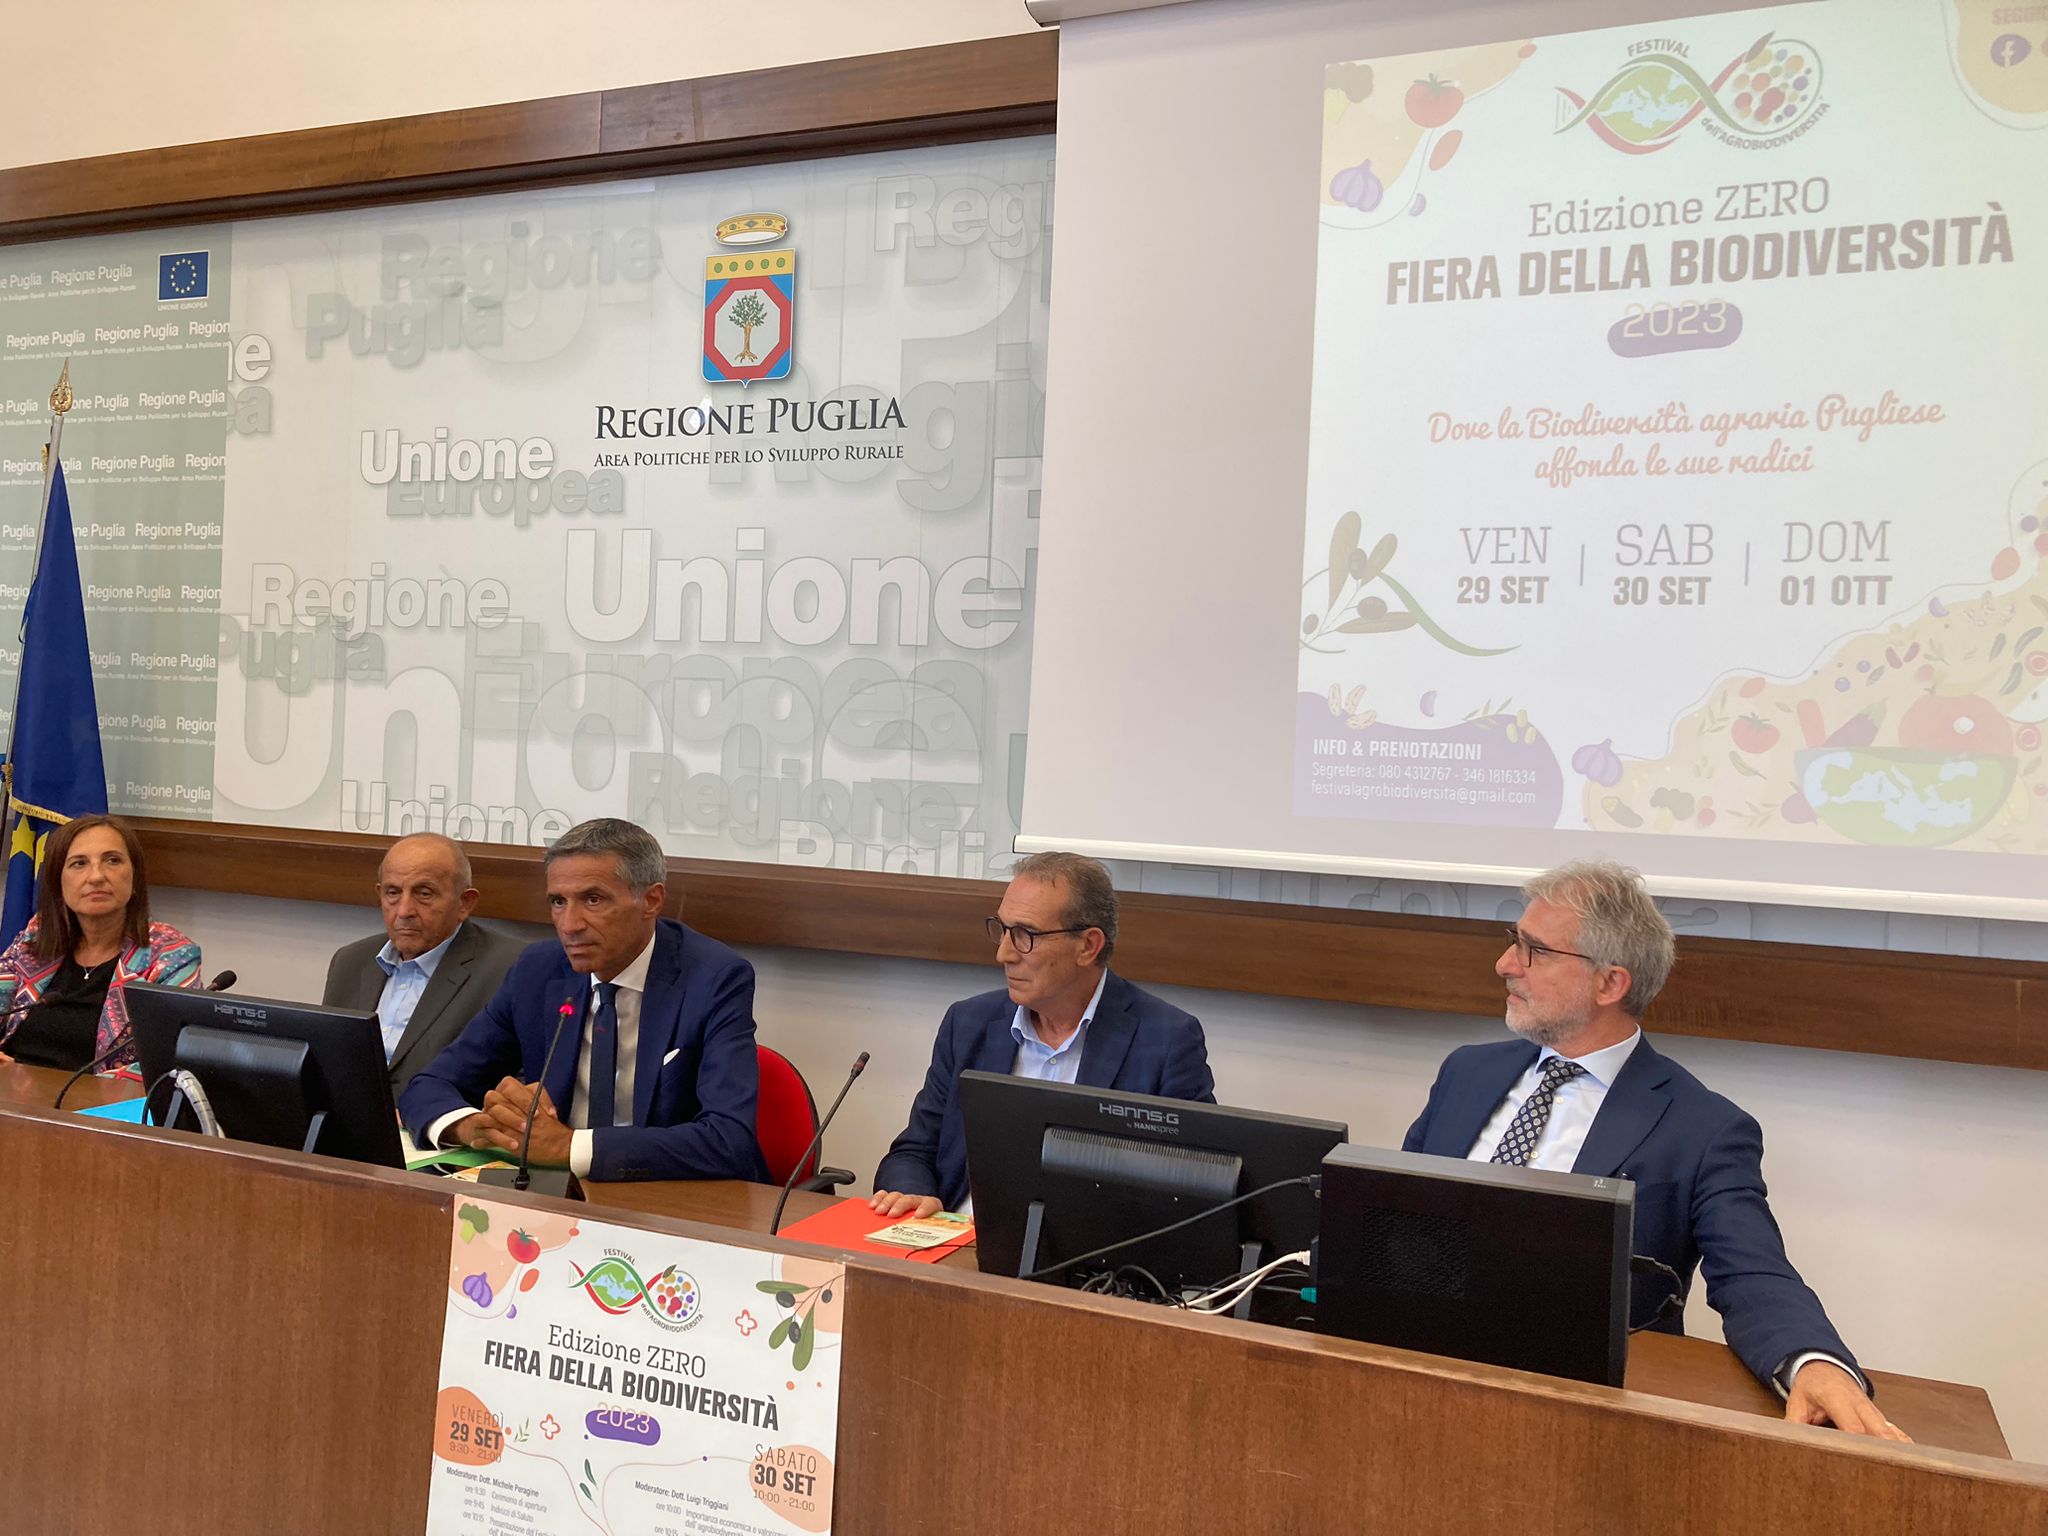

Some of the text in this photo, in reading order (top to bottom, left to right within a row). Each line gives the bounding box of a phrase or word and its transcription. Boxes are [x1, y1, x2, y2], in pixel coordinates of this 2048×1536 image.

[1627, 39, 1690, 59] FESTIVAL
[1528, 177, 1829, 237] Edizione ZERO
[381, 220, 661, 309] Regione
[1387, 202, 2014, 305] FIERA DELLA BIODIVERSITÀ
[10, 272, 42, 290] Puglia
[51, 263, 133, 287] Regione Puglia
[306, 290, 506, 368] Puglia
[1622, 298, 1728, 338] 2023
[7, 333, 49, 350] Regione
[52, 330, 85, 347] Puglia
[95, 327, 141, 344] Regione
[143, 322, 179, 341] Puglia
[6, 398, 38, 415] Puglia
[94, 394, 129, 411] Puglia
[139, 391, 185, 409] Regione
[189, 389, 225, 408] Puglia
[594, 396, 908, 440] REGIONE PUGLIA
[1428, 389, 1945, 448] Dove la Biodiversità agraria Pugliese
[3, 459, 43, 475] Region
[91, 456, 137, 473] Regione
[140, 455, 175, 472] Puglia
[360, 428, 554, 484] Unione
[594, 445, 905, 468] AREA POLITICHE PER LO SVILUPPO RURALE
[1535, 438, 1814, 488] affonda le sue radici
[387, 469, 625, 527] Europea
[3, 524, 34, 541] Puglia
[91, 523, 125, 540] Puglia
[135, 522, 181, 540] Regione
[185, 521, 221, 540] Puglia
[1459, 521, 1892, 567] VEN SAB DOM
[88, 585, 133, 601] Regione
[136, 585, 171, 602] Puglia
[251, 562, 511, 642] Regione
[564, 526, 1023, 650] Unione
[1457, 575, 1893, 606] 29 SET 30 SET 01 OTT
[131, 652, 177, 671] Regione
[180, 653, 216, 672] Puglia
[131, 714, 167, 732] Puglia
[1313, 739, 1482, 760] INFO & PRENOTAZIONI
[1312, 762, 1375, 779] Segreteria:
[1379, 764, 1401, 779] 080
[1404, 764, 1450, 780] 4312767
[1463, 767, 1485, 783] 346
[1489, 768, 1536, 784] 1816334
[126, 781, 172, 799] Regione
[175, 784, 211, 803] Puglia
[1311, 780, 1536, 804] festivalagrobiodiversita@gmail.com
[340, 780, 576, 847] Unione
[603, 1249, 637, 1265] FESTIVAL
[548, 1324, 706, 1379] Edizione ZERO
[484, 1340, 779, 1432] FIERA DELLA BIODIVERSITÀ
[452, 1403, 504, 1430] VENERDÌ
[596, 1402, 650, 1434] 2023
[450, 1421, 503, 1451] 29 SET
[755, 1443, 817, 1474] SABATO
[635, 1480, 729, 1511] Moderatore: Dott. Luigi Triggiani
[754, 1463, 816, 1497] 30 SET
[753, 1489, 780, 1504] 10:00
[789, 1497, 815, 1512] 21:00
